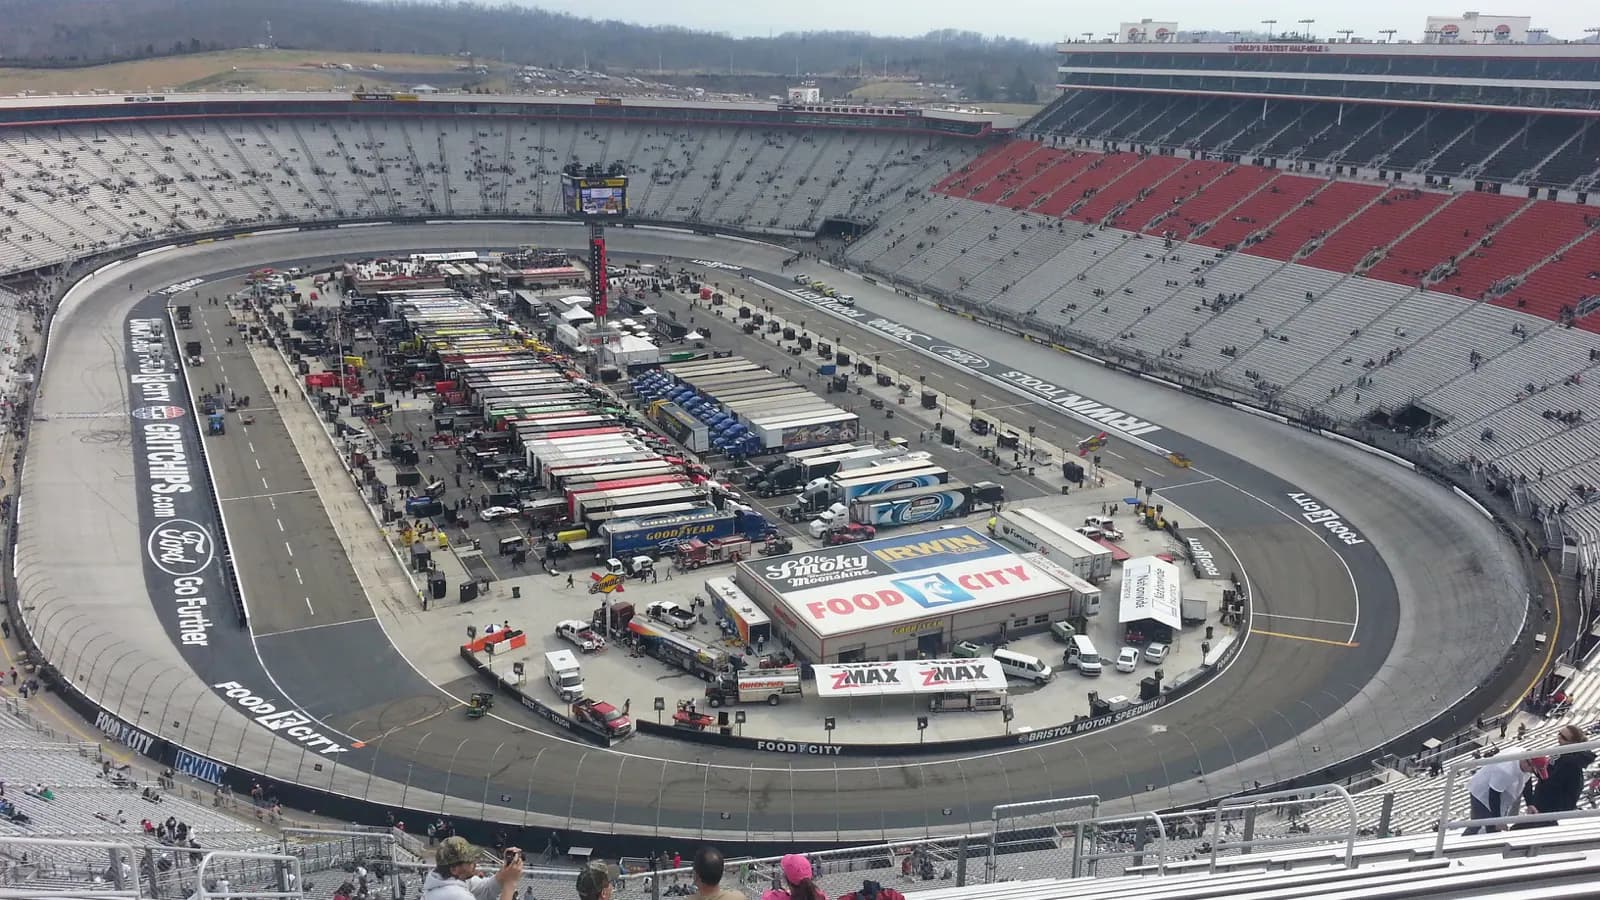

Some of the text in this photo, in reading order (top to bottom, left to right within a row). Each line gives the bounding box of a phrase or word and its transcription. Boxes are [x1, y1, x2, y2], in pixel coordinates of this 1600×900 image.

[142, 382, 171, 401] CITY
[1002, 371, 1162, 436] IRWIN TOOLS
[1287, 492, 1365, 545] FOOD CITY
[766, 555, 868, 580] Smoky
[873, 535, 982, 562] IRWIN
[787, 569, 878, 588] Moonshine
[806, 589, 905, 619] FOOD
[958, 565, 1031, 591] CITY
[173, 576, 213, 647] Go Further
[95, 711, 120, 737] FOOD
[127, 729, 154, 754] CITY
[214, 681, 348, 754] FOOD CITY
[1028, 700, 1159, 742] BRISTOL MOTOR SPEEDWAY
[175, 750, 224, 784] IRWIN
[757, 741, 797, 753] FOOD
[808, 745, 842, 755] CITY
